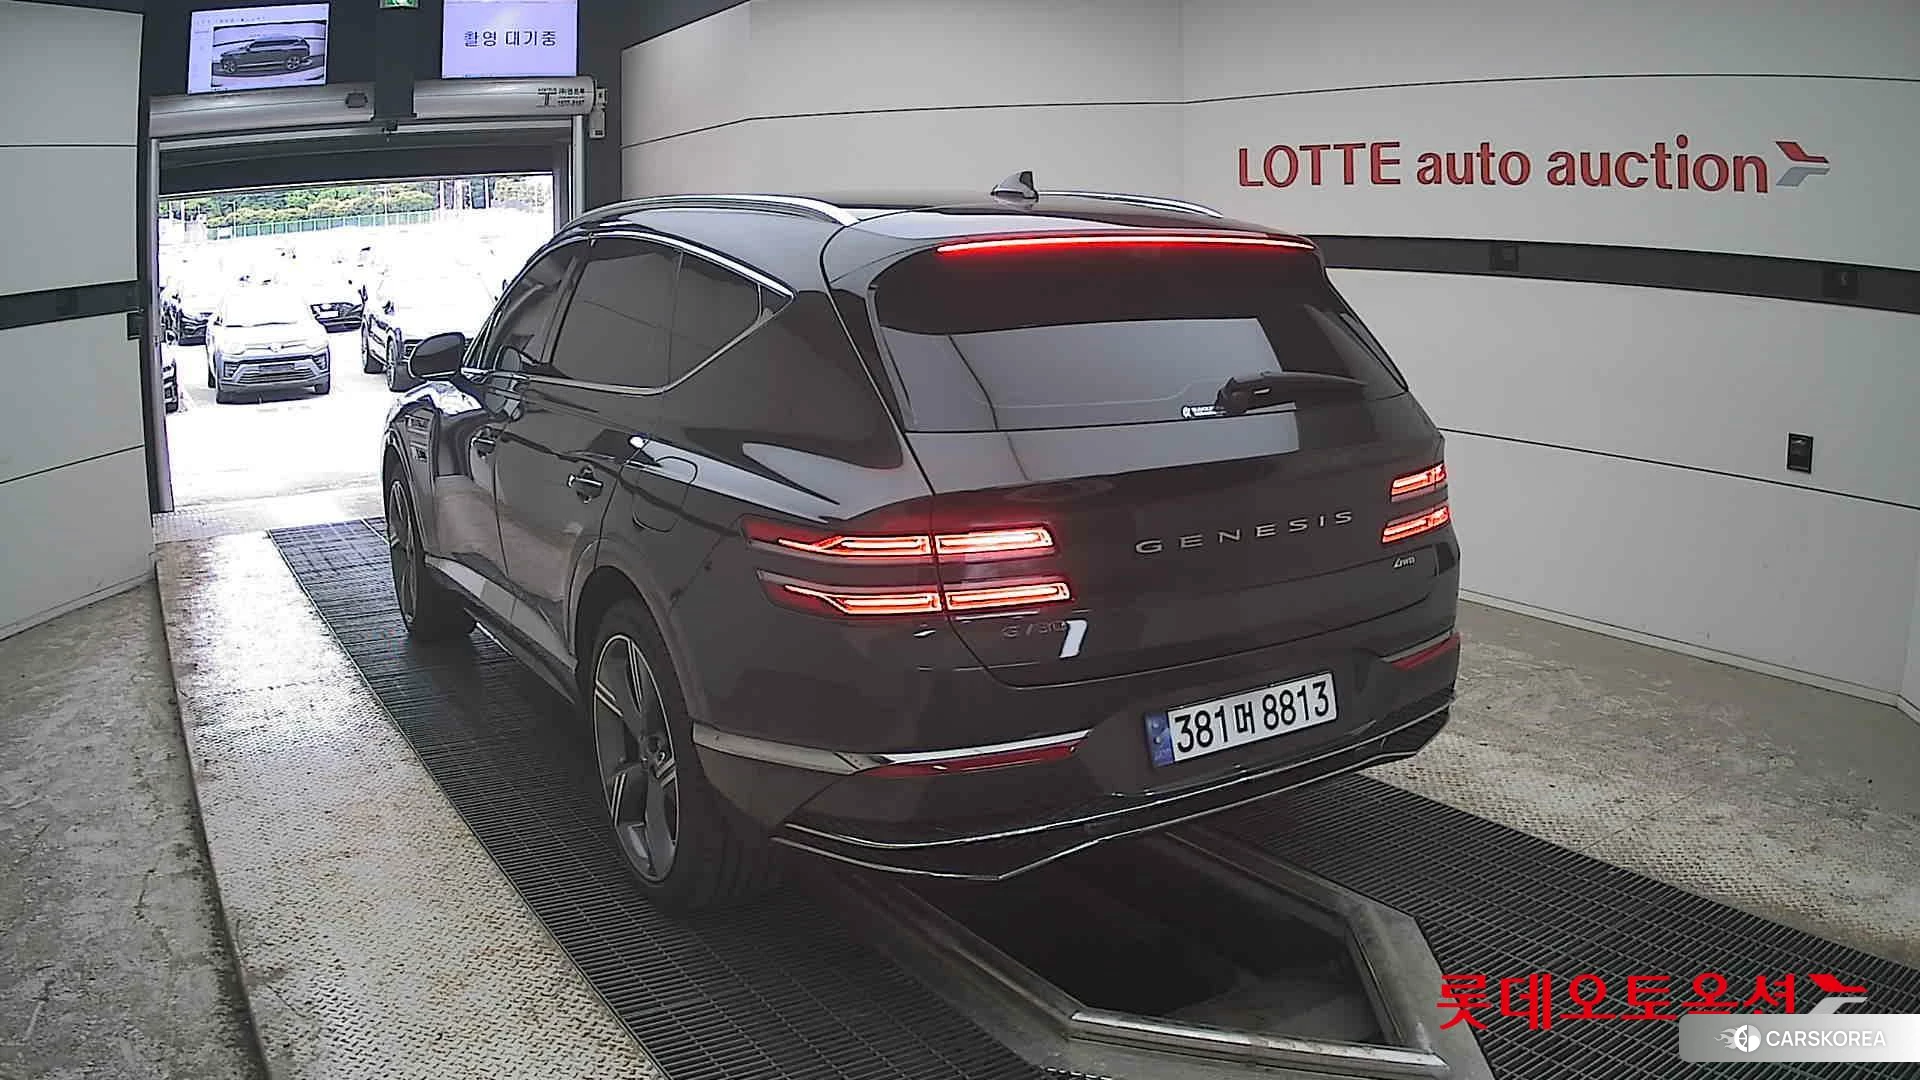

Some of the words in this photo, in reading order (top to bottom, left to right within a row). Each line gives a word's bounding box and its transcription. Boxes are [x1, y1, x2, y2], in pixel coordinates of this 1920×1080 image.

[505, 30, 557, 47] 대기중
[1238, 141, 1402, 188] LOTTE
[1416, 142, 1532, 187] auto
[1547, 134, 1769, 194] auction
[1134, 509, 1355, 555] GENESIS
[1262, 680, 1330, 731] 8813
